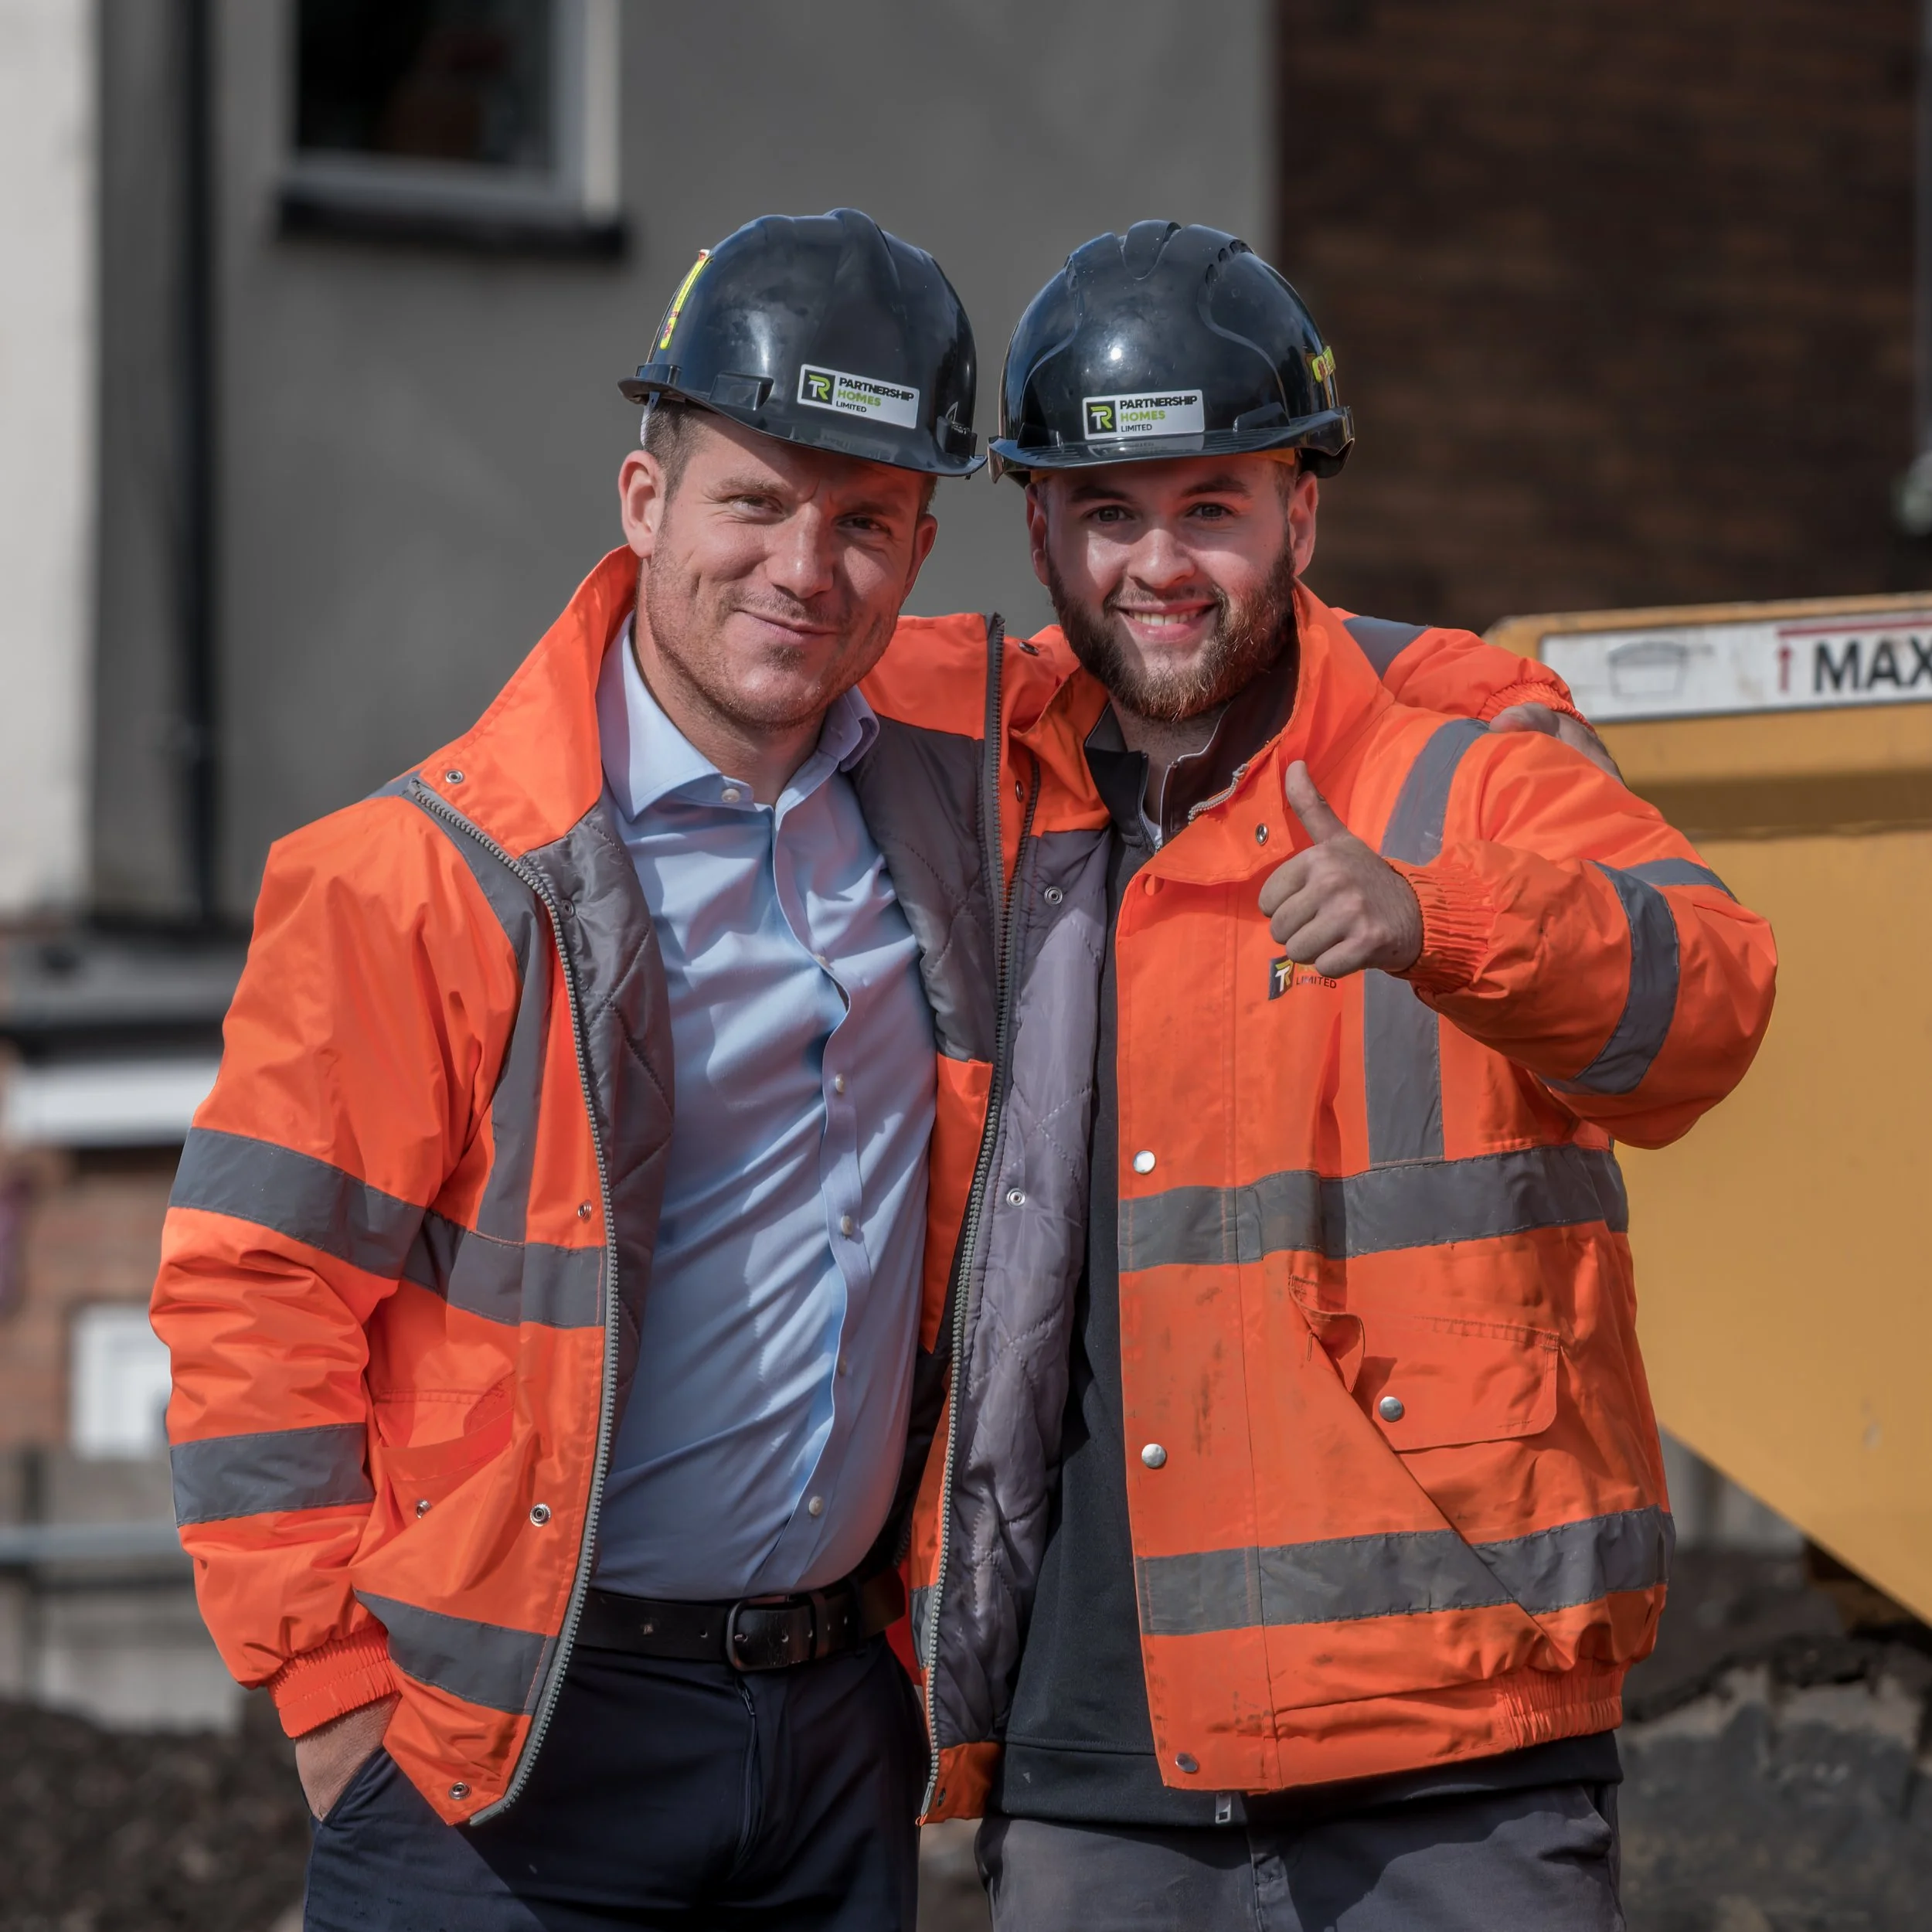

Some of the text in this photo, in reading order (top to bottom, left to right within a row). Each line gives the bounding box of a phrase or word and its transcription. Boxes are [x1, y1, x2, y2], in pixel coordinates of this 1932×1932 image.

[838, 377, 914, 401] PARTNERSHIP
[837, 389, 882, 406] HOMES
[1120, 396, 1197, 410] PARTNERSHIP
[835, 400, 867, 413] LIMITED
[1121, 410, 1165, 422] HOMES
[1814, 634, 1932, 693] MAX
[1296, 976, 1337, 989] LIMITED
